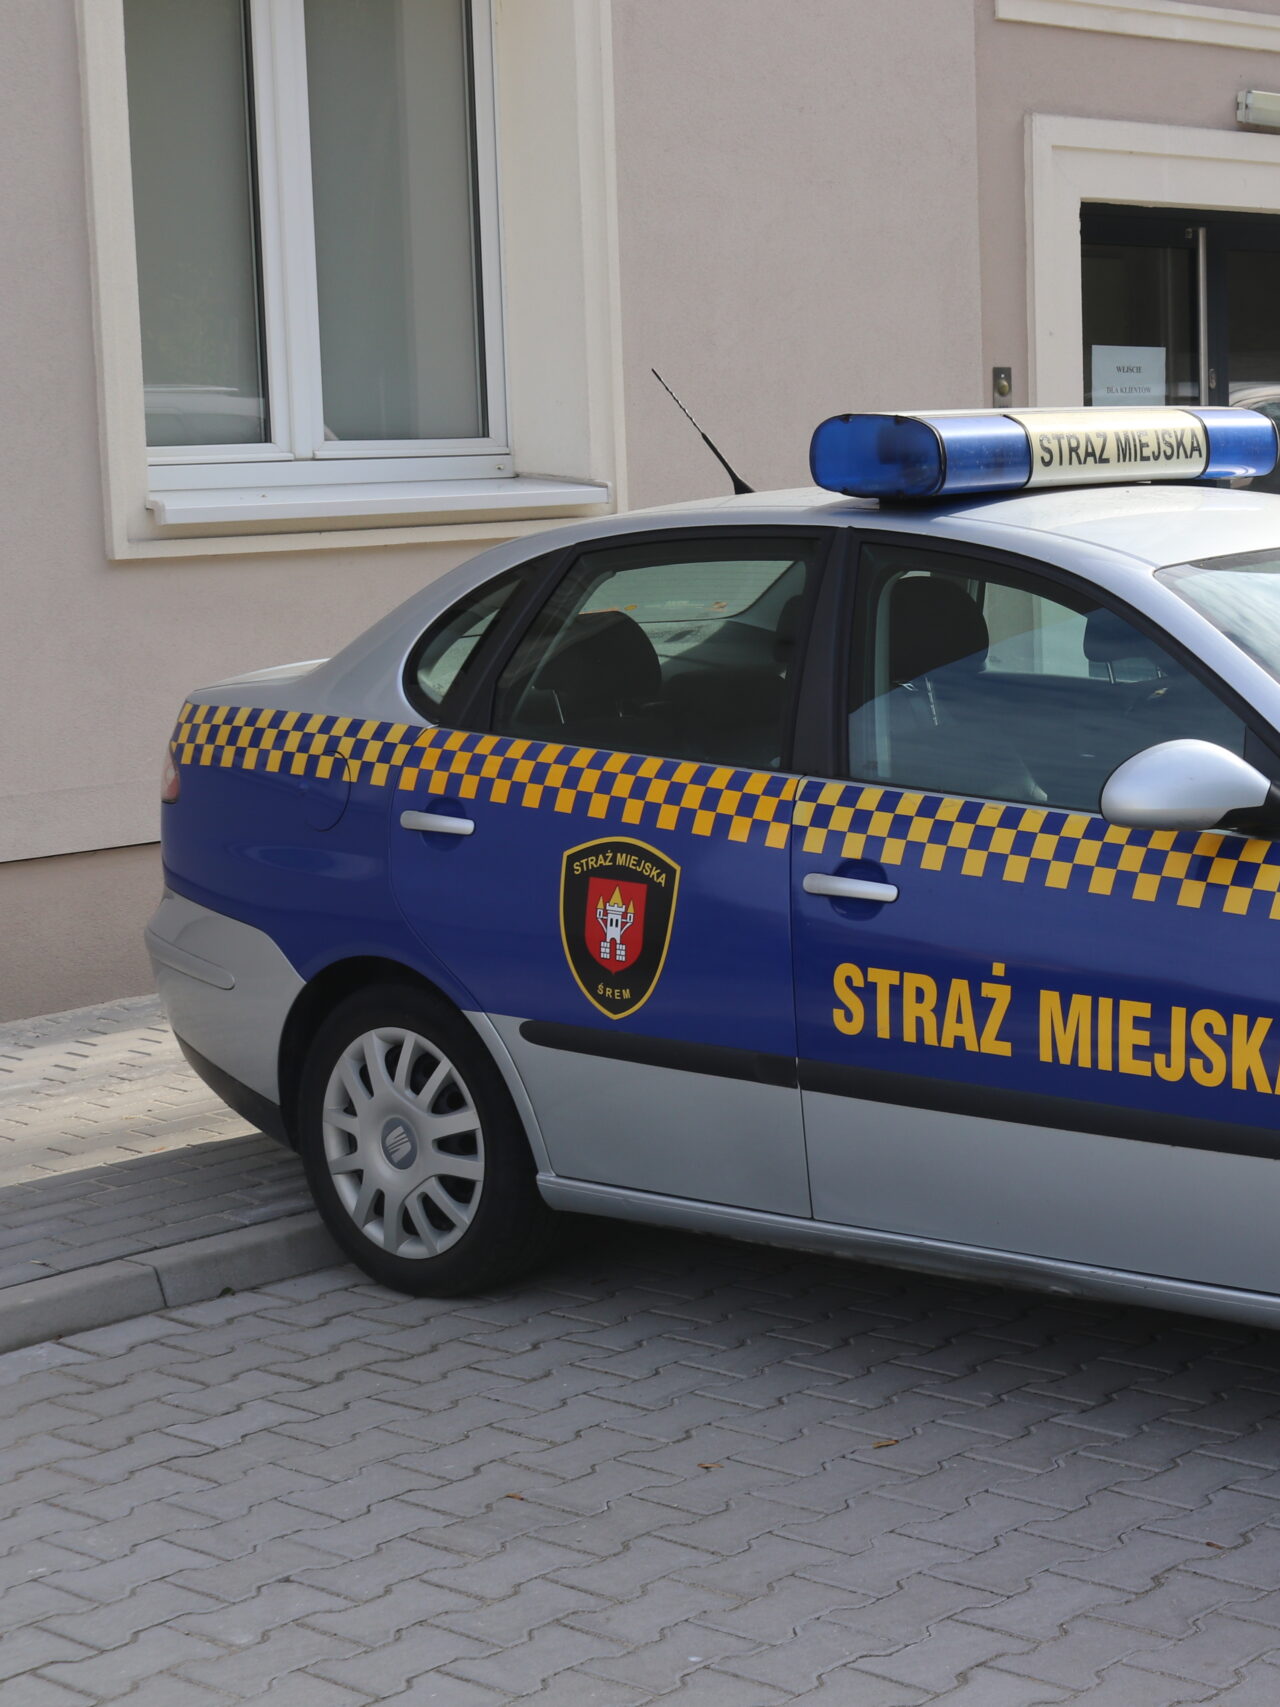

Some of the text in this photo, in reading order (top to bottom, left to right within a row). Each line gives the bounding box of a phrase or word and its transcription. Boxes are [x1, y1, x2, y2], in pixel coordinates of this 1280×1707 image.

[1114, 428, 1203, 464] MIEJSKA
[573, 850, 668, 888] STRAŻ MIEJSKA
[596, 982, 632, 1000] ŚREM
[832, 961, 1013, 1058] STRAŻ
